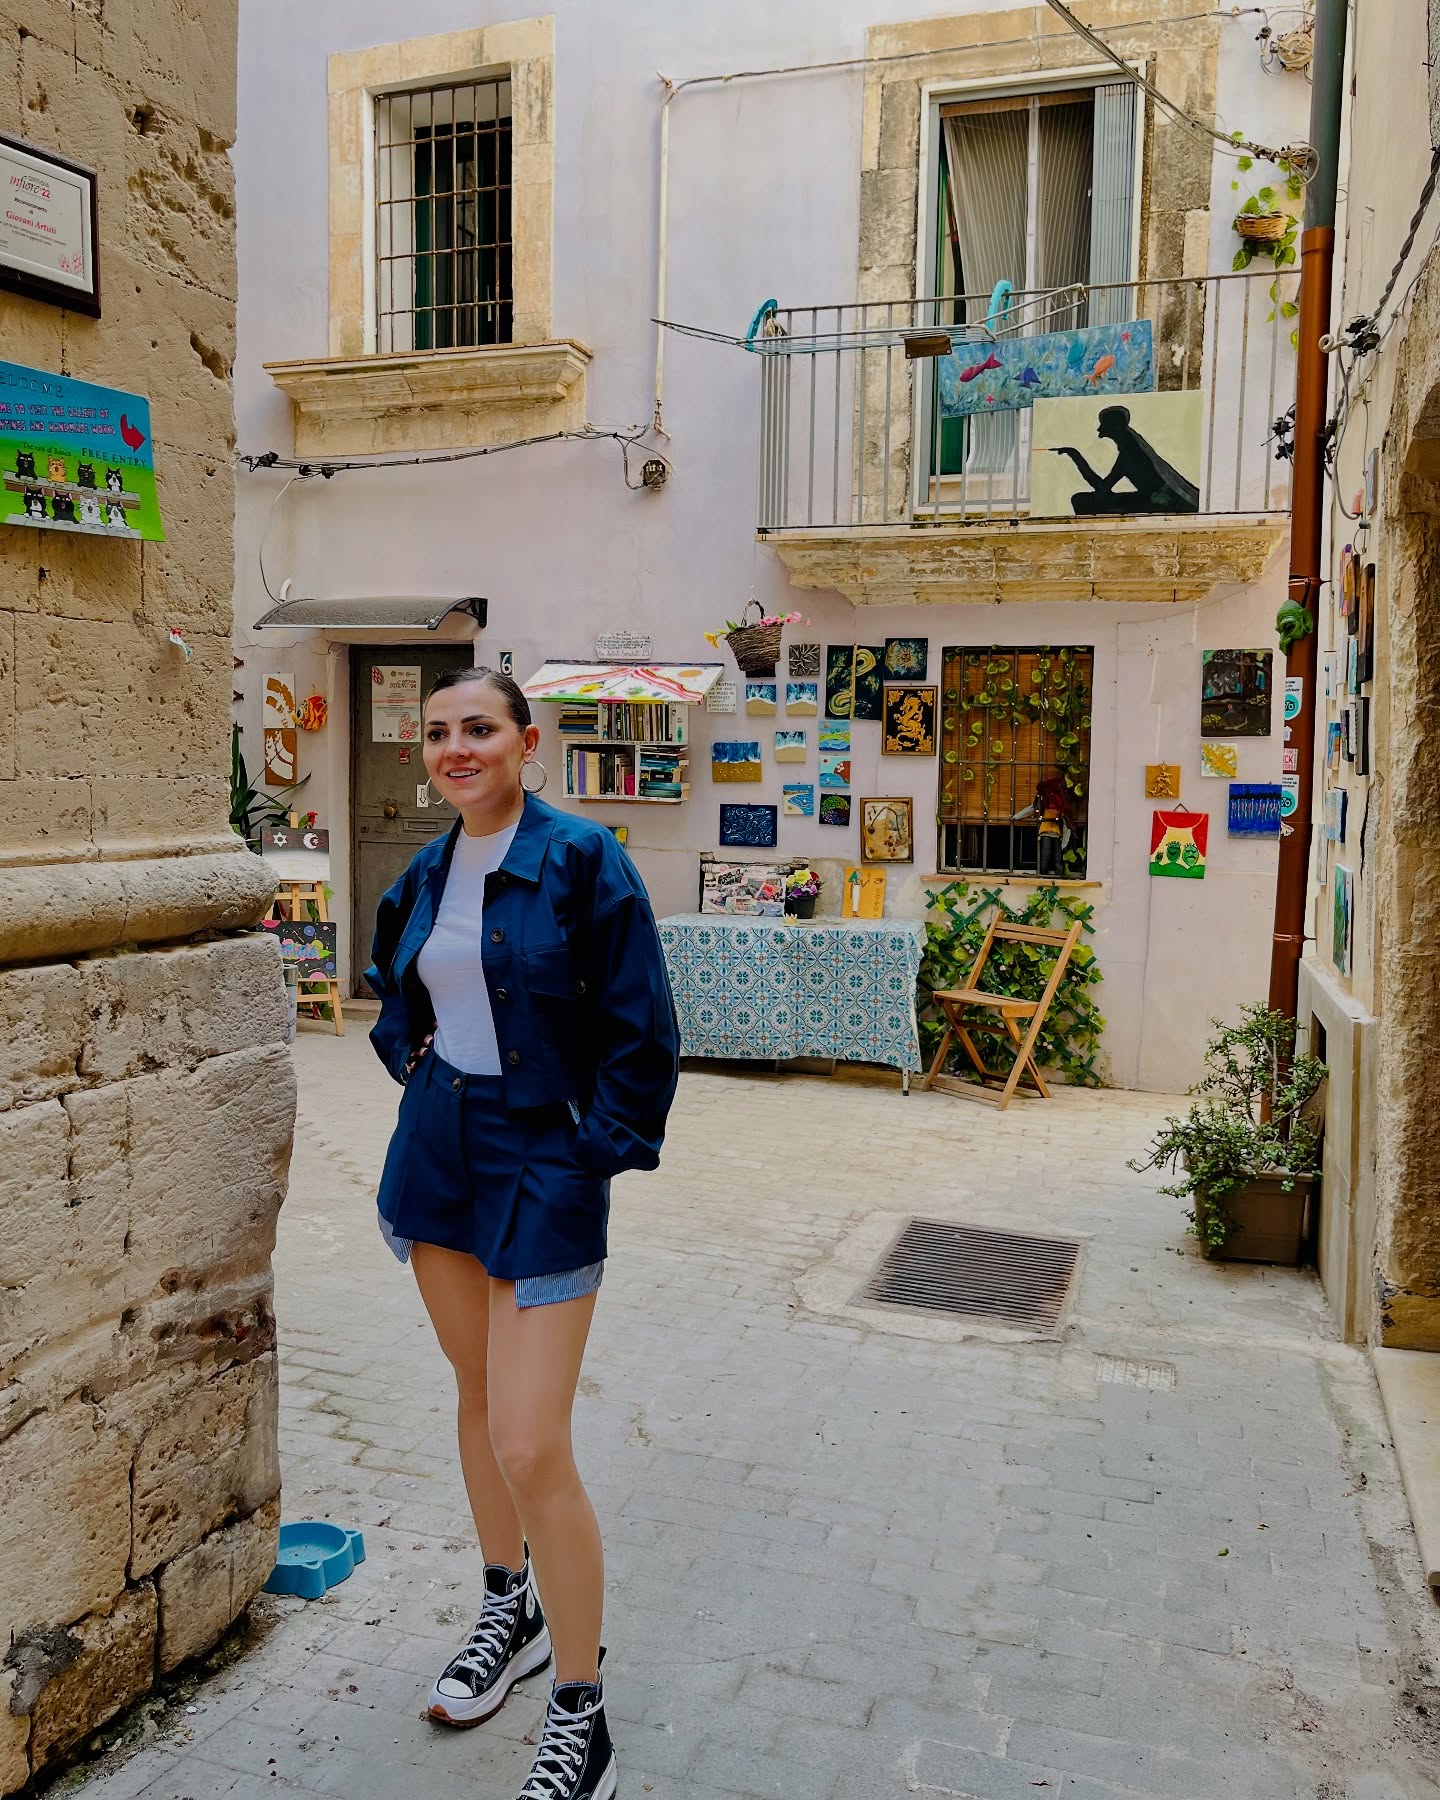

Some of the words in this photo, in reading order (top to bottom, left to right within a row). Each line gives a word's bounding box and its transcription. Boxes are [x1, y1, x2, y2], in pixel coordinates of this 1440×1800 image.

[6, 210, 34, 227] Giovani
[36, 221, 56, 234] Artisti
[14, 403, 25, 415] TO
[50, 405, 65, 417] THE
[68, 406, 96, 418] GALLERY
[99, 408, 109, 419] OF
[30, 420, 45, 431] AND
[48, 421, 89, 434] HANDMADE
[81, 447, 108, 462] FREE
[112, 454, 147, 468] ENTRY
[501, 654, 512, 675] 6
